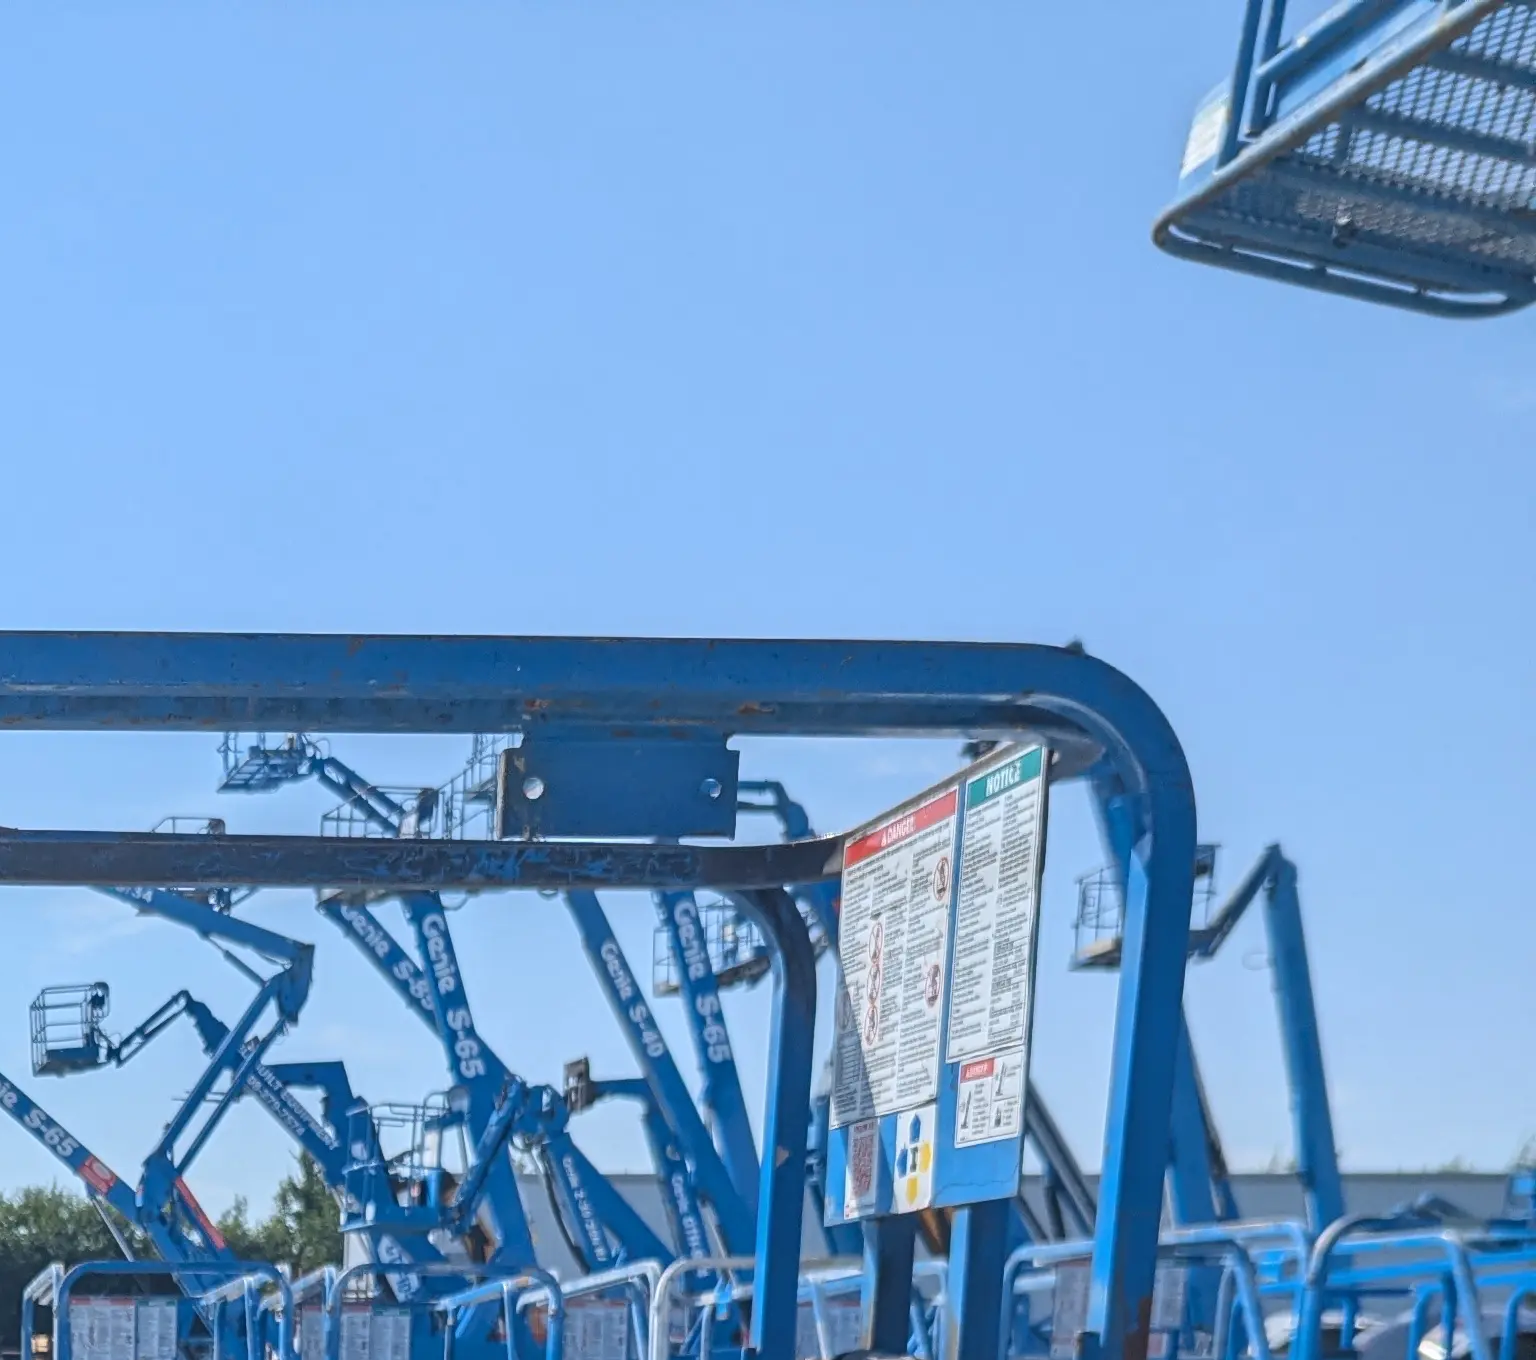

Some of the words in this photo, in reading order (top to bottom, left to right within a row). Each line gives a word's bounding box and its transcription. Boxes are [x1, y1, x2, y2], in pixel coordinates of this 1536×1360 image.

[421, 913, 456, 995] Genie
[446, 1008, 486, 1079] S-65
[600, 939, 633, 1001] Genie
[628, 1003, 664, 1058] S-40
[673, 901, 706, 981] Genie
[695, 994, 733, 1063] S-65
[23, 1108, 80, 1157] S-65
